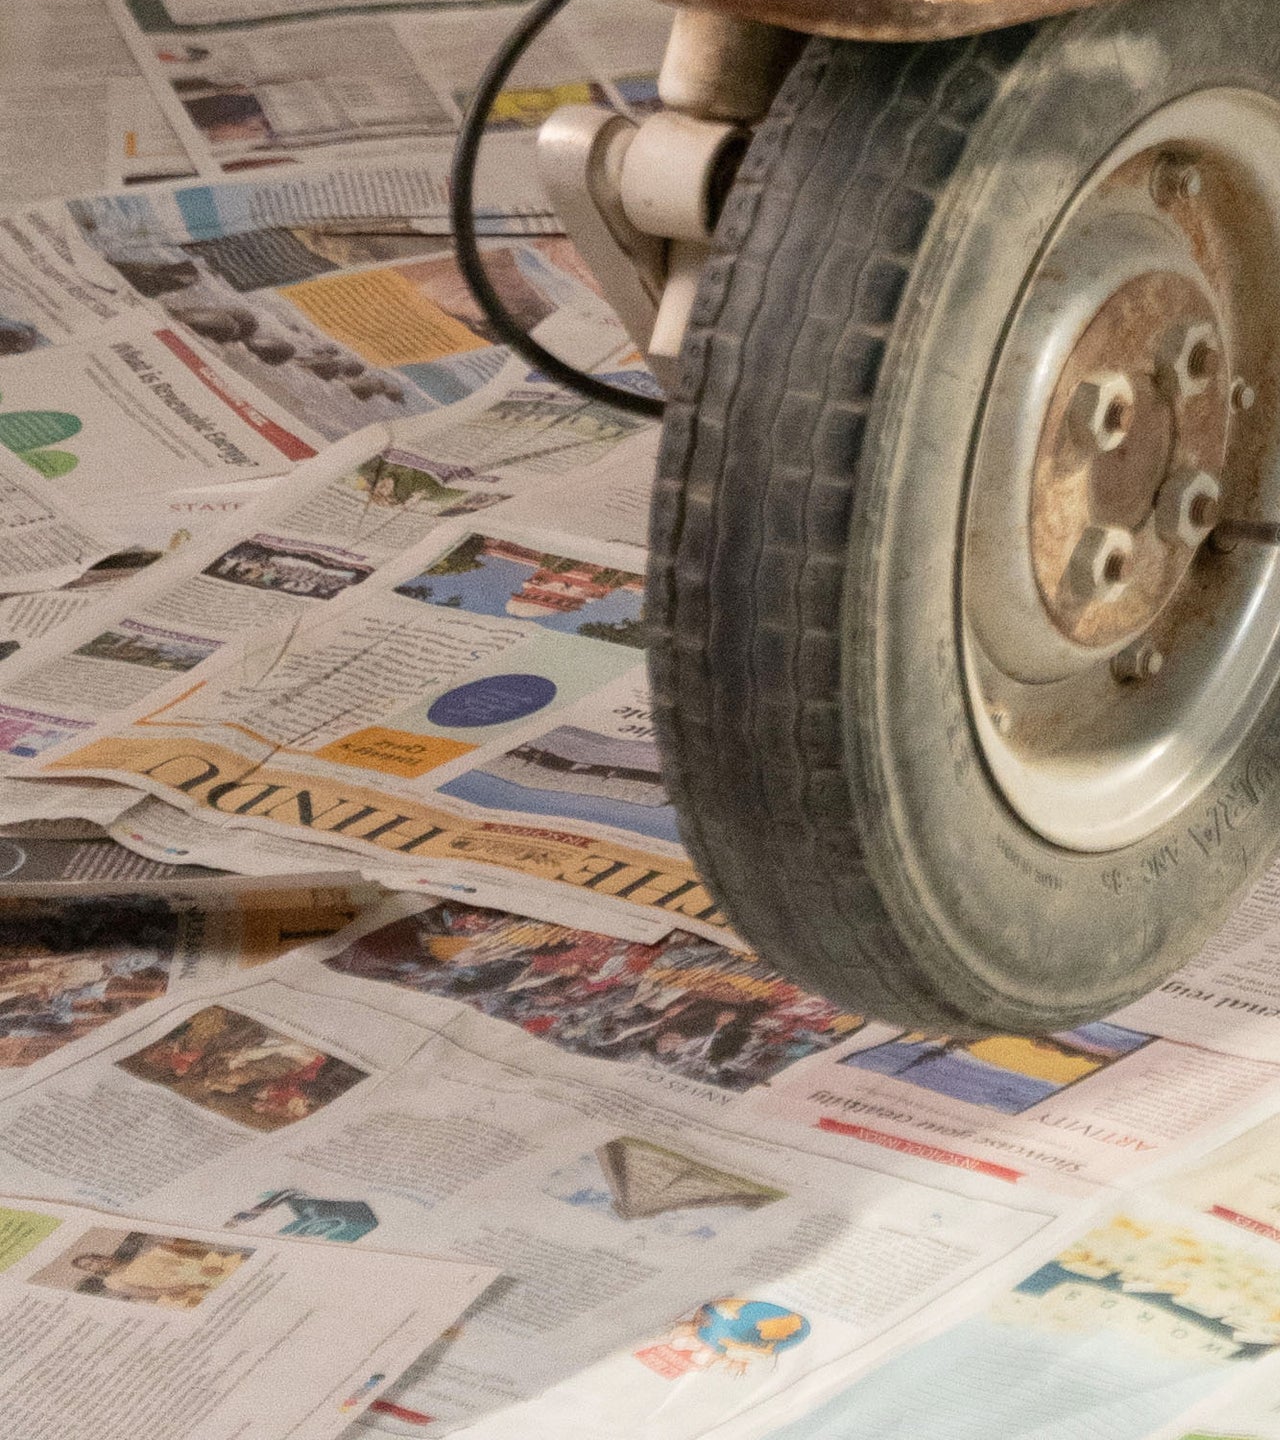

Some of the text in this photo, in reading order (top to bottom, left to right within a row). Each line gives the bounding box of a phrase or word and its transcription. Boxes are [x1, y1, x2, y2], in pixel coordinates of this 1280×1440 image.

[139, 370, 163, 384] is
[142, 753, 446, 853] HINDU
[807, 1089, 915, 1125] creativity
[918, 1120, 977, 1140] your
[1035, 1112, 1161, 1153] ARTIVITY
